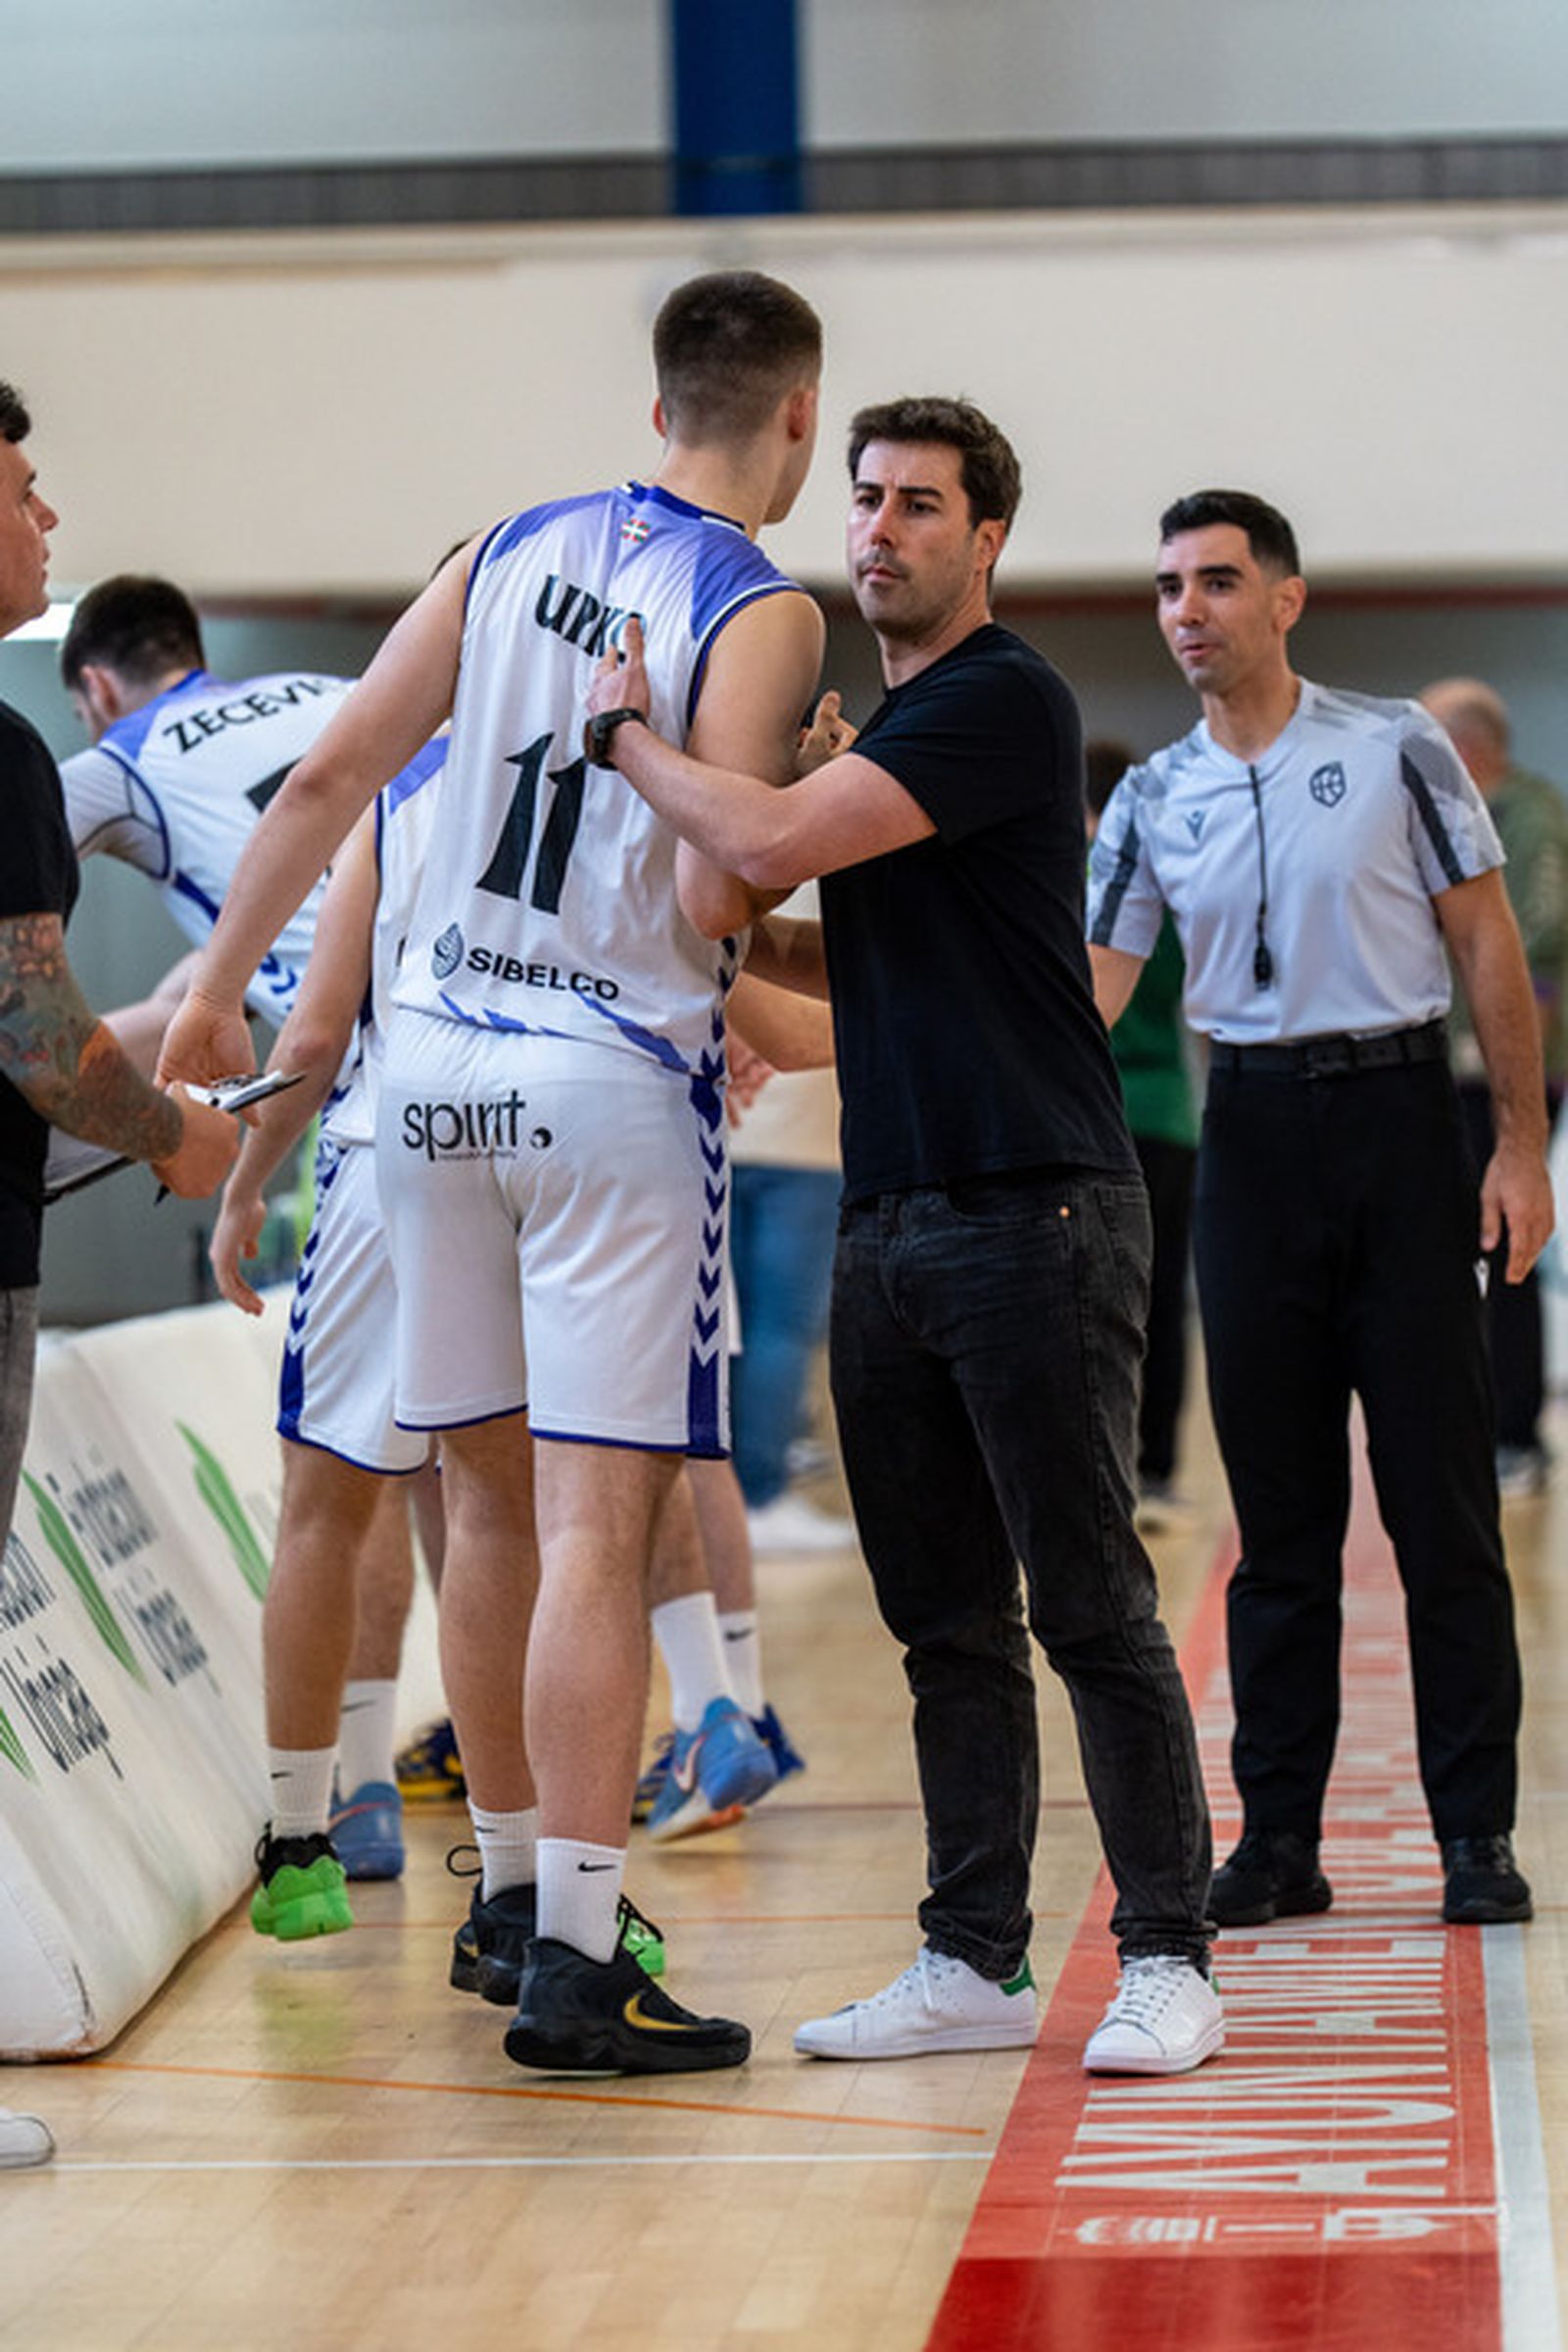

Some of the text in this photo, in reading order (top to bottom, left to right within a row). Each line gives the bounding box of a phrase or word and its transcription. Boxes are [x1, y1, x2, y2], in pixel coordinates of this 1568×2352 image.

[162, 678, 325, 754] ZECEVI
[475, 731, 587, 915] 11
[466, 948, 619, 1001] SIBELCO
